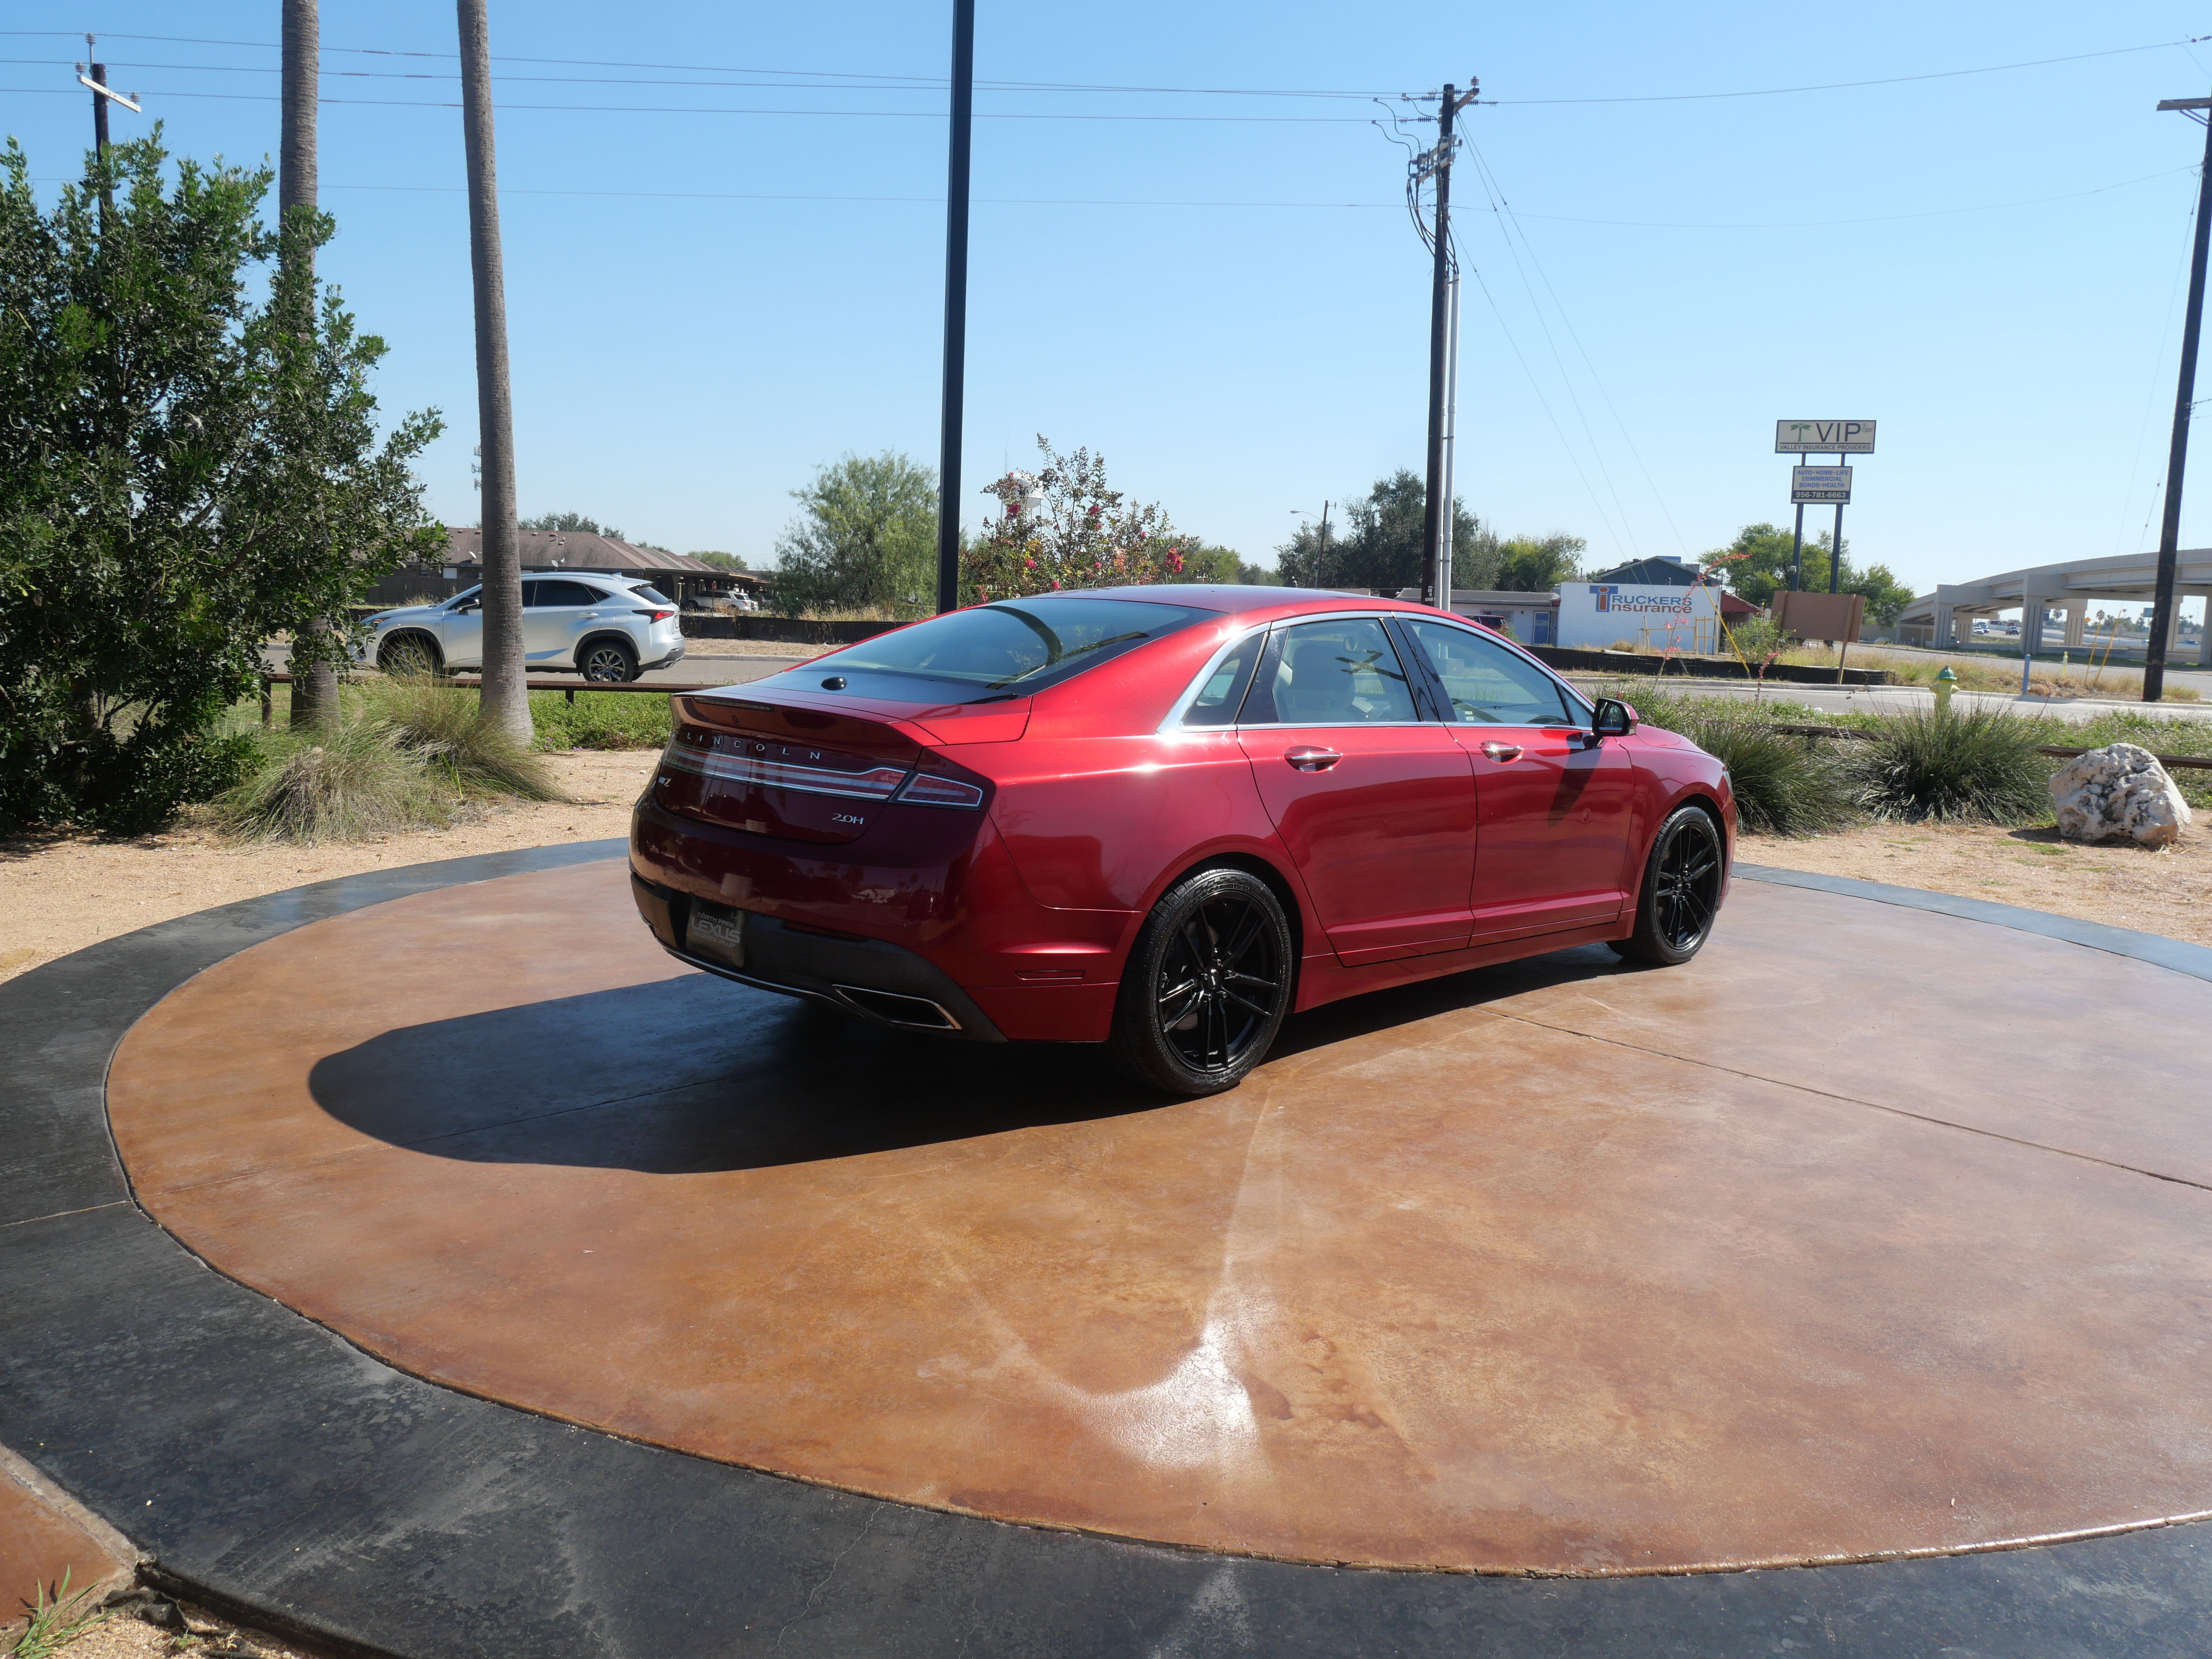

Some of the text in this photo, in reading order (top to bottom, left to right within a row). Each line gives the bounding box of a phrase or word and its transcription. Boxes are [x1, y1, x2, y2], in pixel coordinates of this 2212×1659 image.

[1816, 423, 1861, 442] VIP
[687, 732, 821, 760] LINCOLN
[691, 916, 741, 943] LEXUS
[718, 919, 735, 928] PARK
[719, 938, 736, 948] VALLEY
